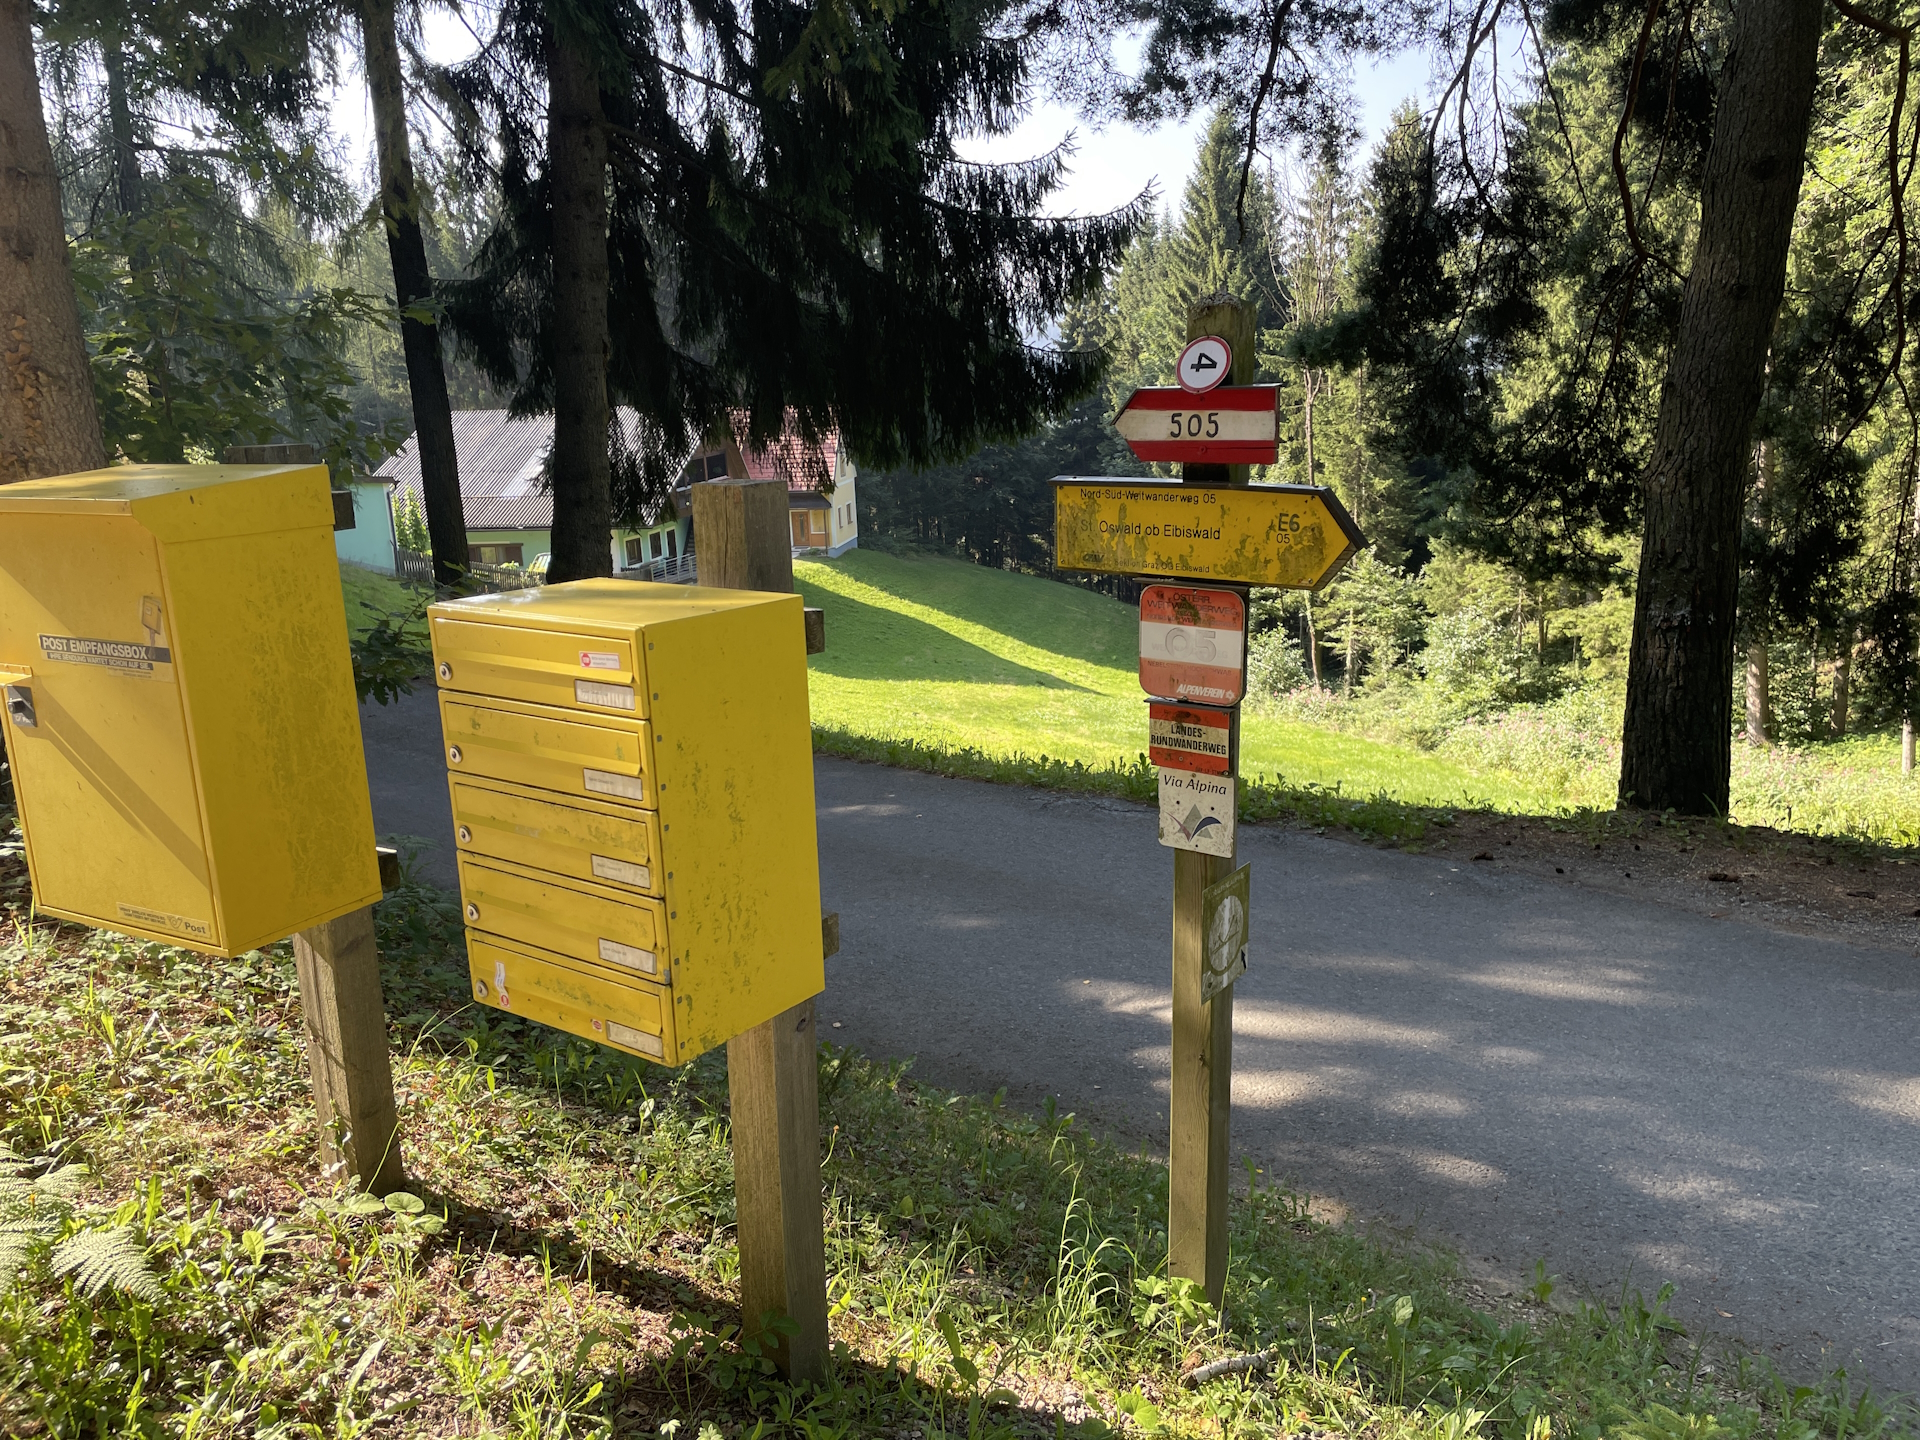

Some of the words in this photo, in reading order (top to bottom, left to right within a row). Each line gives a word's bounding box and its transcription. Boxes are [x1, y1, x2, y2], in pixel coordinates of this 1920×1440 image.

[1190, 352, 1218, 373] 4
[1170, 412, 1219, 438] 505
[1080, 488, 1199, 504] Nord-Süd-Weitwanderweg
[1203, 494, 1217, 504] 05
[1099, 520, 1141, 535] Oswald
[1145, 525, 1160, 536] ob
[1163, 524, 1221, 540] Eibiswald
[1278, 512, 1300, 533] E6
[1276, 533, 1290, 544] 05
[1142, 560, 1159, 570] Graz
[1161, 561, 1173, 571] OG
[42, 636, 68, 651] POST
[70, 639, 148, 660] EMPFANGSBOX
[1165, 627, 1217, 662] 05
[1176, 683, 1225, 699] ALPENVEREIN
[1171, 724, 1207, 738] LANDES-
[1150, 734, 1227, 755] RUNDWANDERWEG
[1164, 774, 1183, 788] Via
[1186, 778, 1227, 795] Alpina
[184, 921, 206, 934] Post
